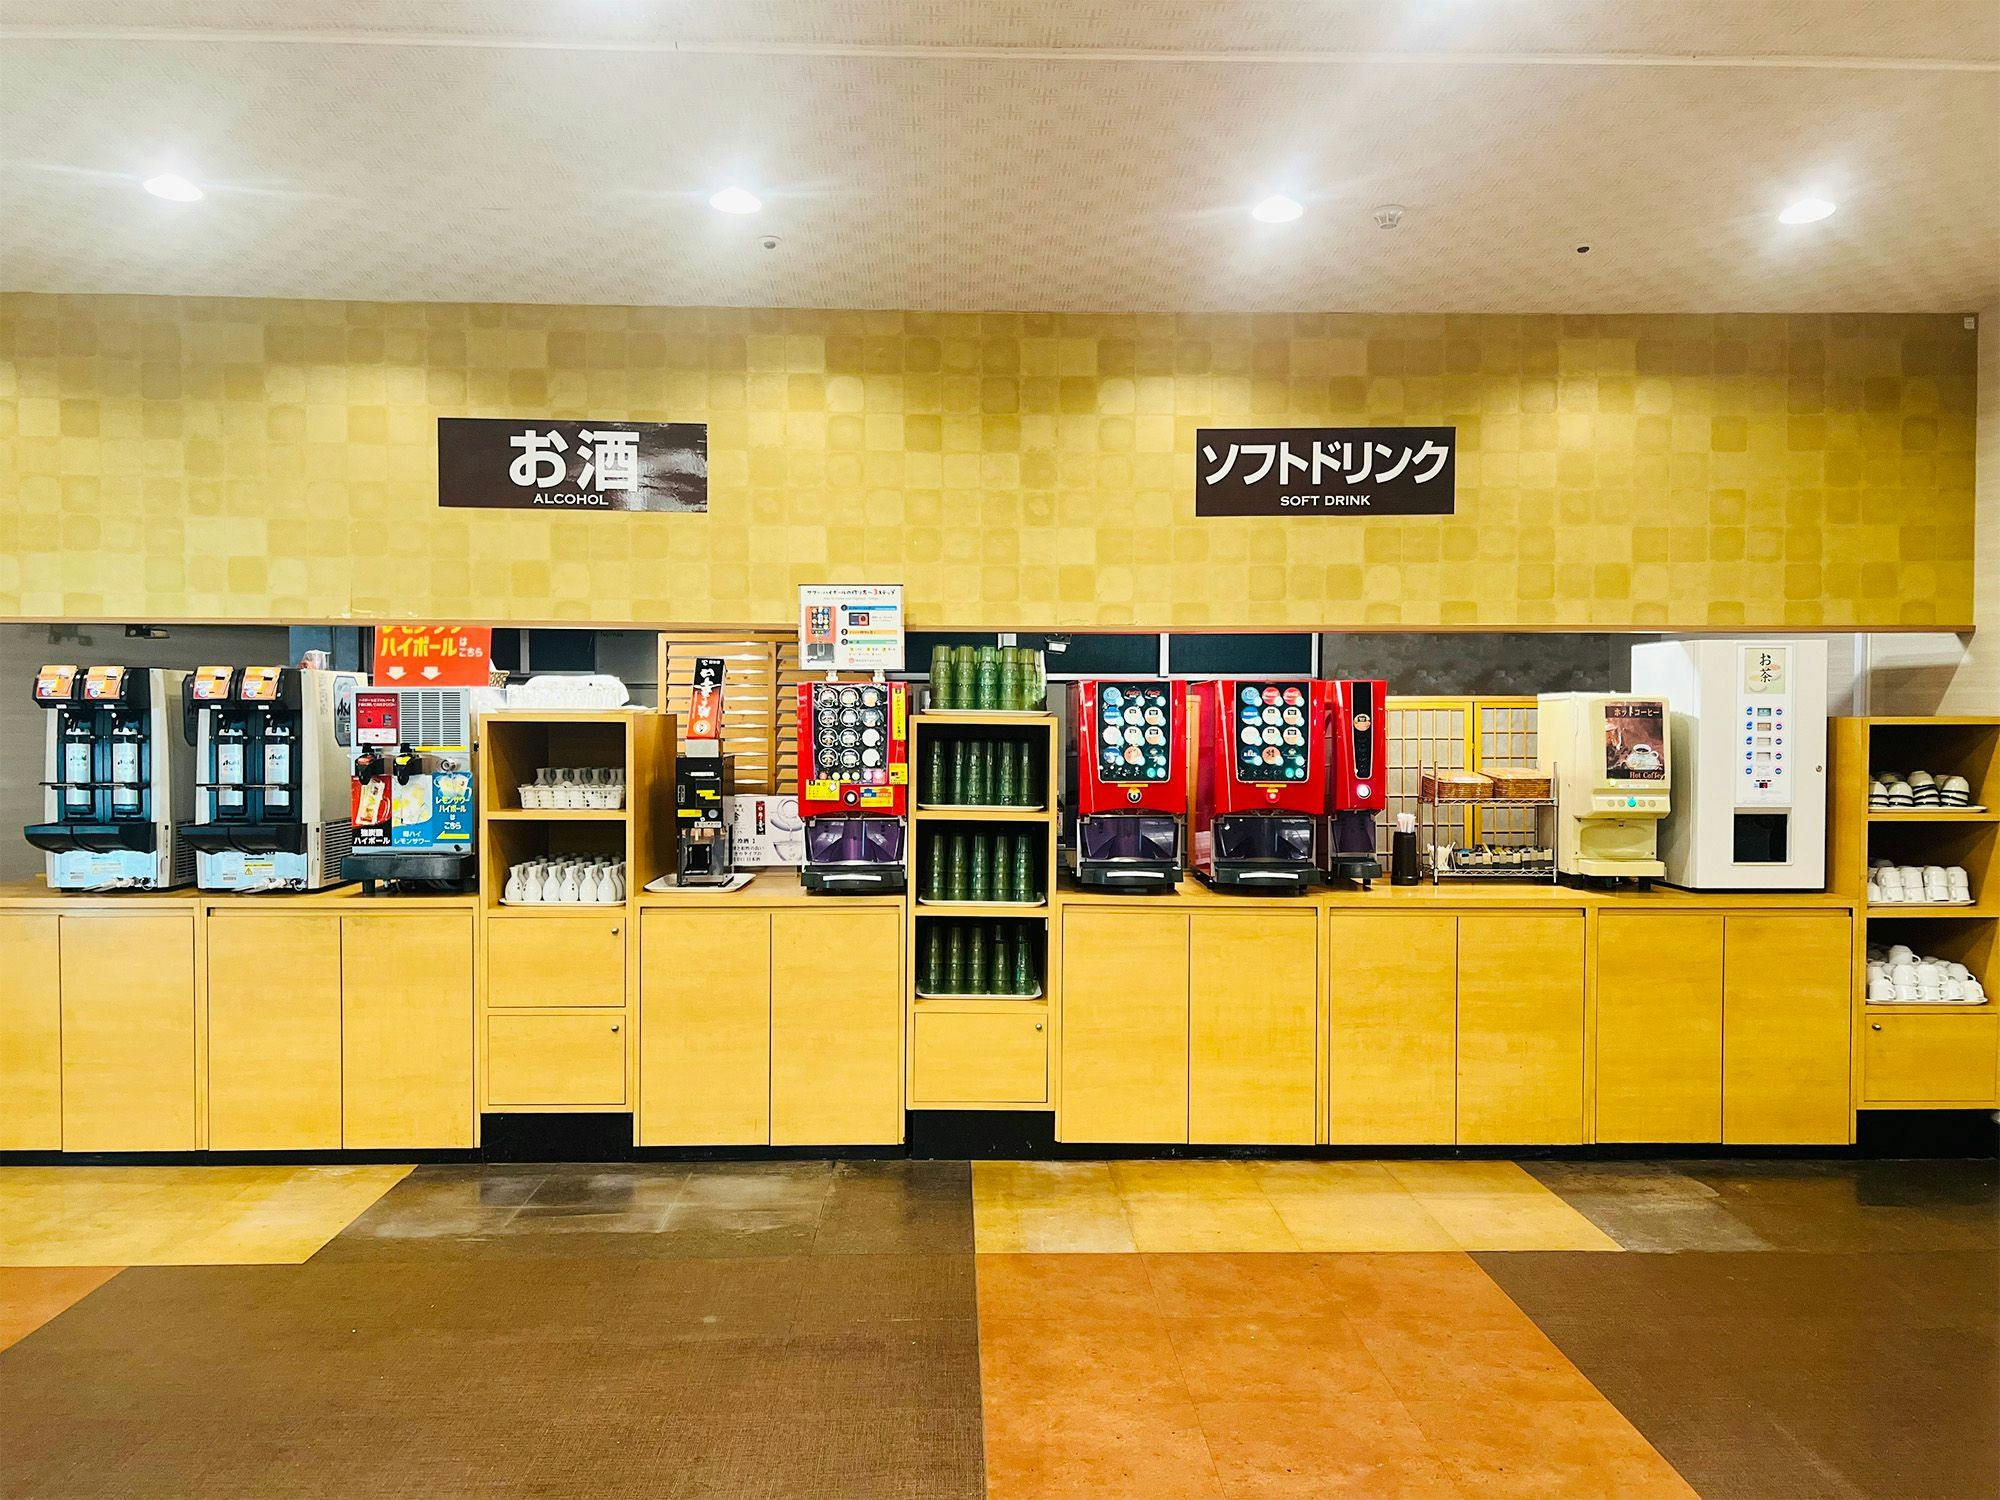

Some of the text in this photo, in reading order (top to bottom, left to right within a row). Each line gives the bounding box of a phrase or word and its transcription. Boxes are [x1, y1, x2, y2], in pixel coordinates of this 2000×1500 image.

[509, 429, 640, 491] お酒
[1202, 440, 1449, 486] ソフトドリンク
[533, 493, 609, 506] ALCOHOL
[1280, 494, 1371, 506] SOFT DRINK
[380, 636, 458, 657] ハイボール
[458, 637, 467, 647] は
[458, 647, 483, 657] こちら
[1759, 653, 1772, 683] お茶
[1614, 708, 1659, 717] ホットコーヒー
[439, 805, 467, 813] ハイボール
[354, 837, 390, 845] ハイボール
